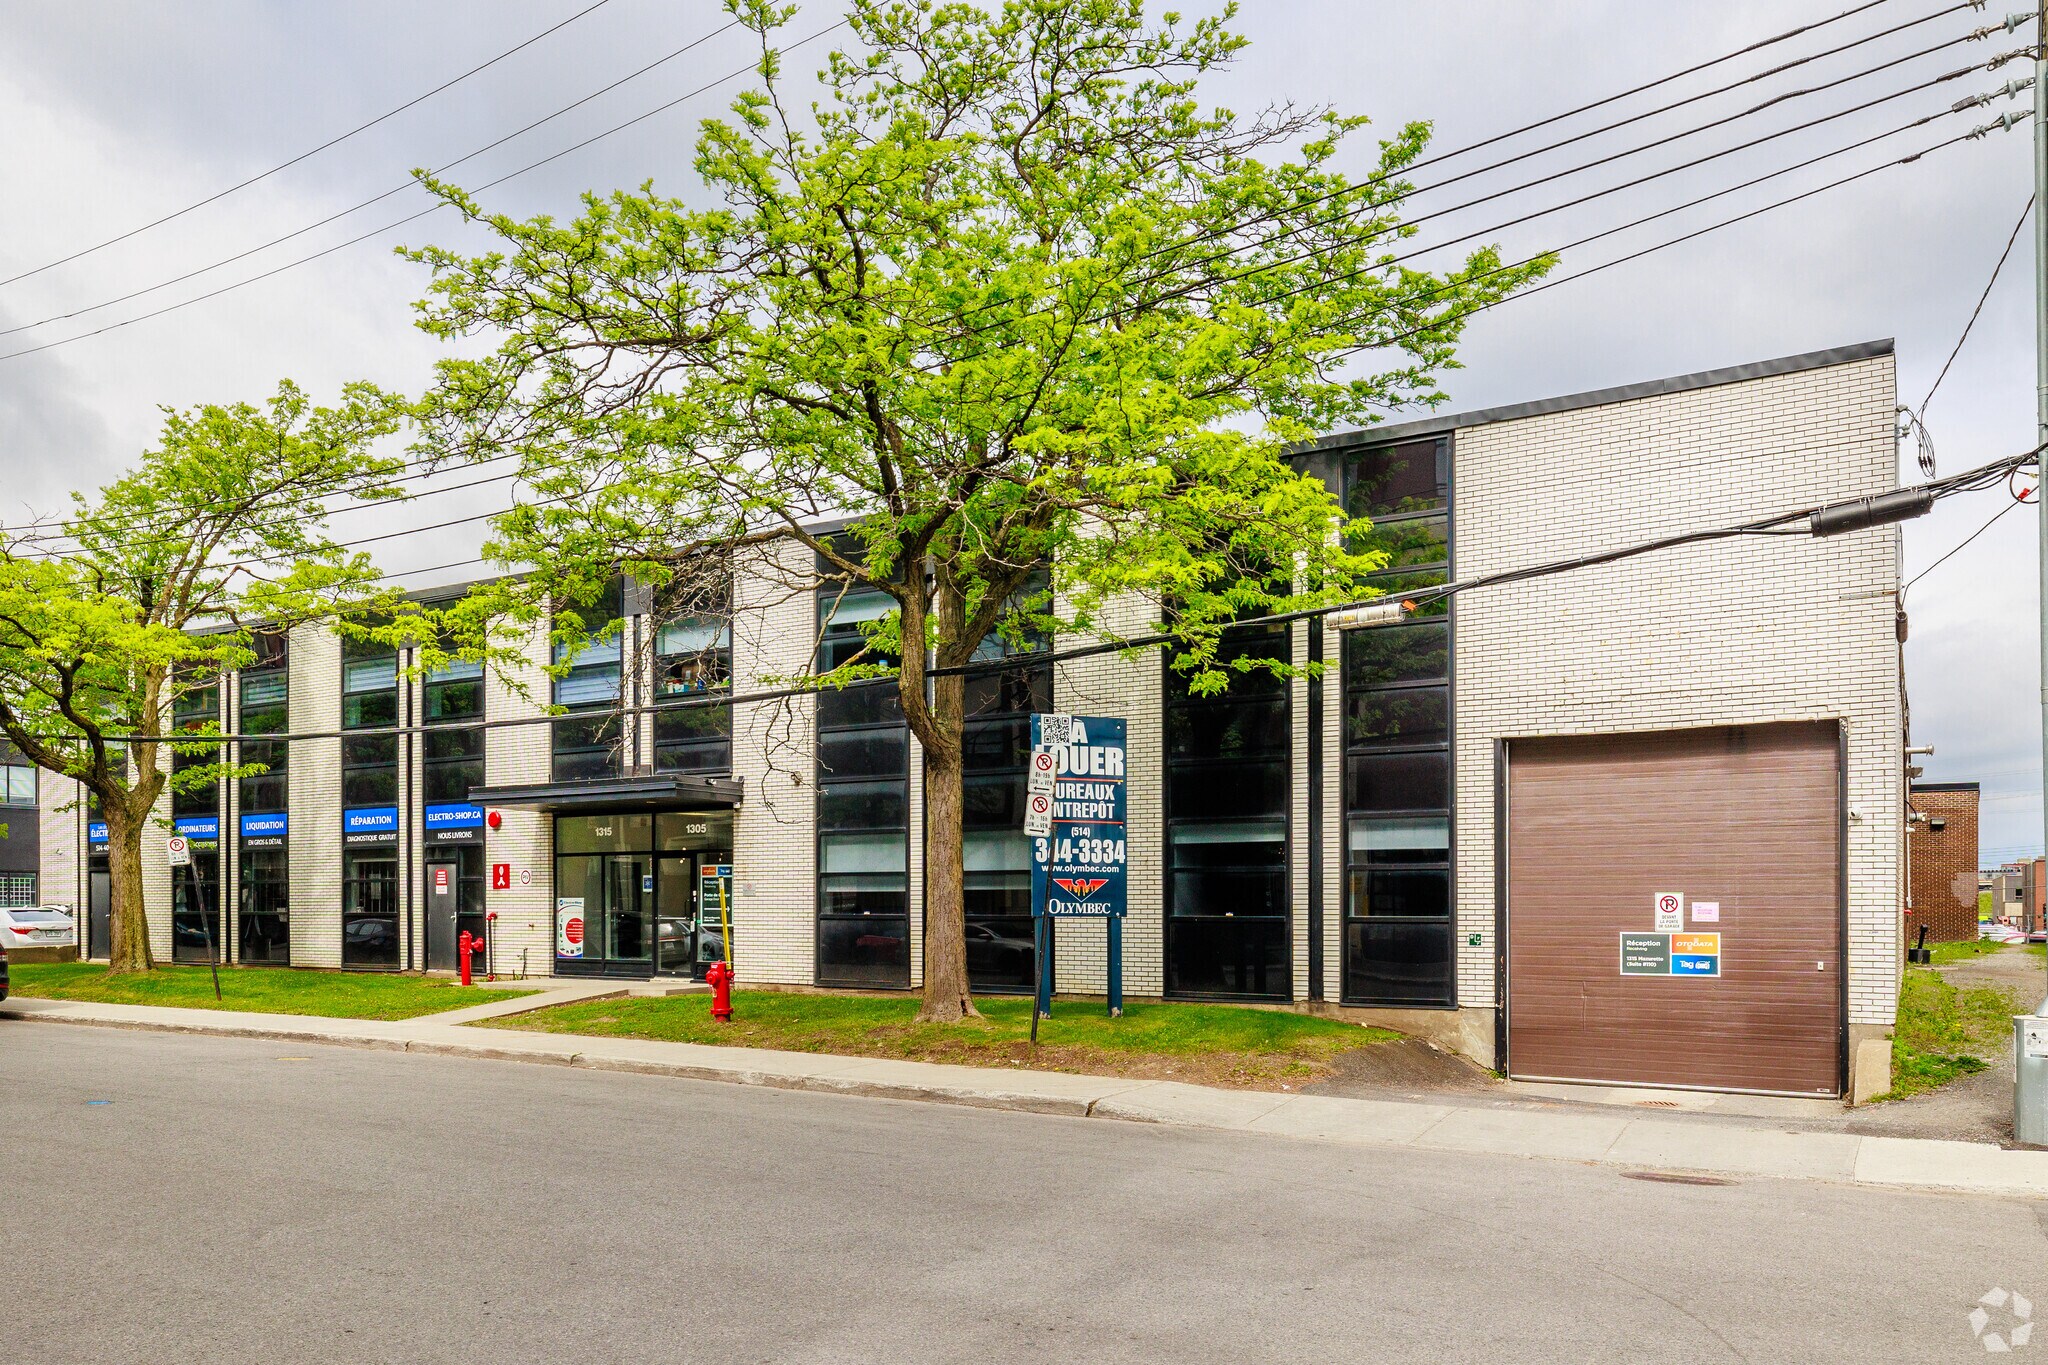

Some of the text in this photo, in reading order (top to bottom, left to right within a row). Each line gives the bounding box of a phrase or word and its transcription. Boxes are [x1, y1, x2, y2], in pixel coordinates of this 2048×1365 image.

[1035, 744, 1124, 776] OUER
[1055, 783, 1115, 801] UREAUX
[1053, 801, 1115, 819] NTREPÔT
[350, 816, 392, 826] RÉPARATION
[428, 811, 481, 821] ELECTRO-SHOP.CA
[177, 824, 216, 834] ORDINATEURS
[246, 821, 284, 831] LIQUIDATION
[686, 824, 707, 834] 1305
[452, 831, 473, 839] LIVRONS
[595, 827, 612, 837] 1315
[1071, 827, 1091, 838] (514)
[1680, 960, 1694, 969] Tag
